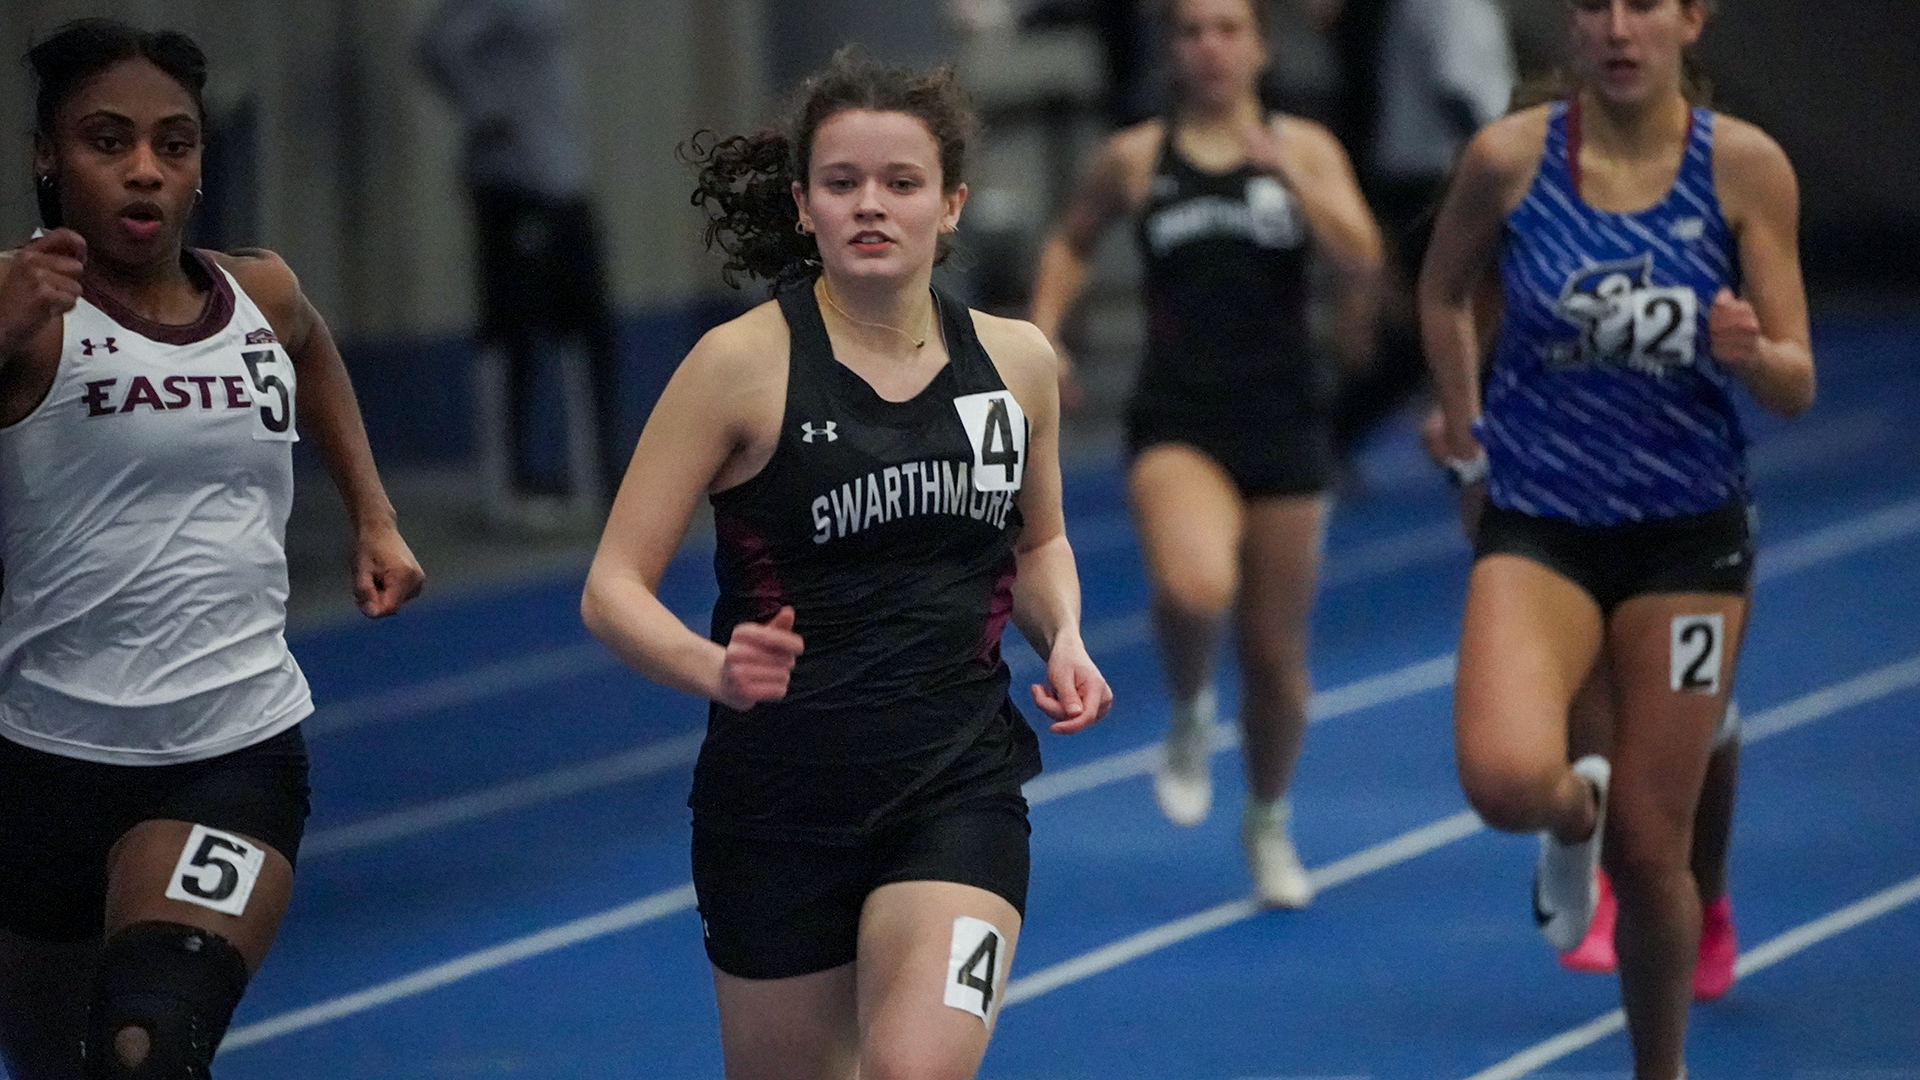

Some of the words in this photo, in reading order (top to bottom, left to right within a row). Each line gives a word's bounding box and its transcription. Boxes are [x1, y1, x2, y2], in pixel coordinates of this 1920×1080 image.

[1643, 297, 1683, 363] 2
[81, 375, 253, 417] EASTE
[241, 350, 290, 432] 5
[972, 398, 1018, 482] 4
[811, 459, 1015, 545] SWARTHMORE
[1680, 621, 1714, 687] 2
[181, 833, 248, 901] 5
[957, 930, 998, 1016] 4
